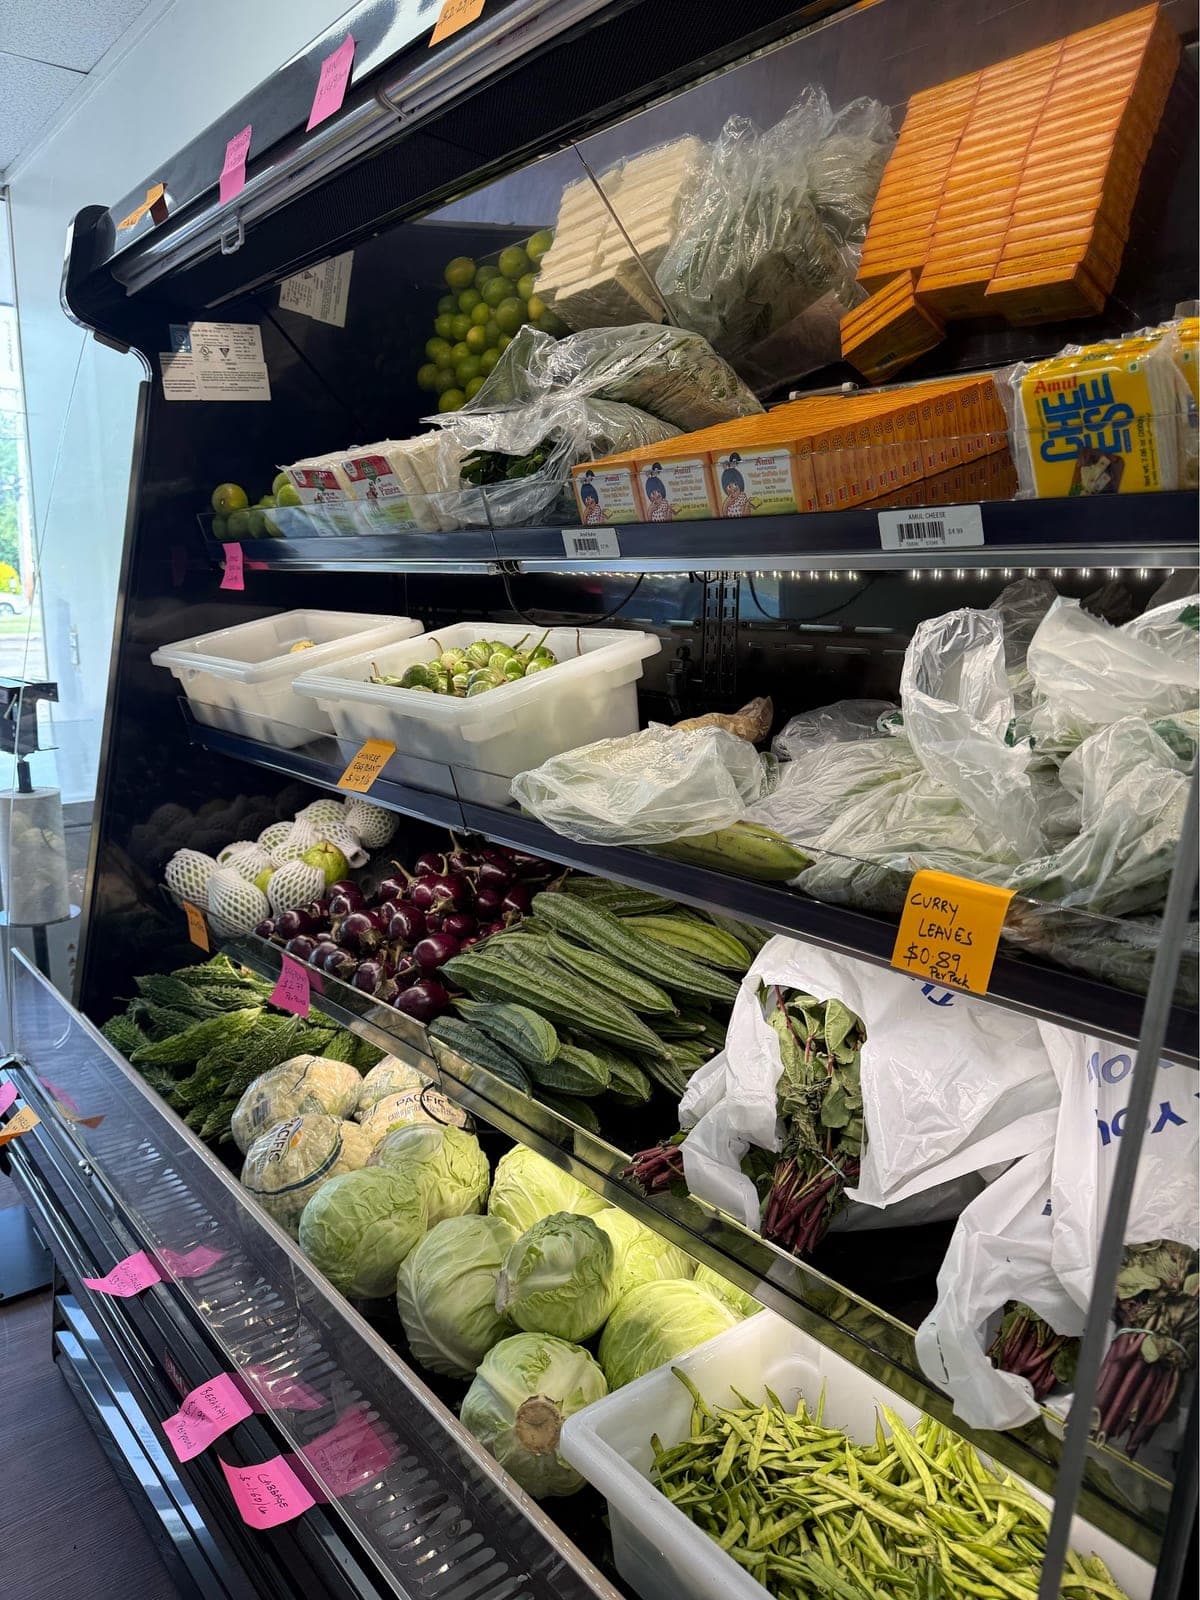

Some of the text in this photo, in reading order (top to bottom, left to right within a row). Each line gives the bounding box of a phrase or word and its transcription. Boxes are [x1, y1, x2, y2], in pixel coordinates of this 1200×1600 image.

[1033, 374, 1078, 394] Amul
[910, 893, 959, 926] CURRY
[918, 918, 973, 946] LEAVES
[903, 941, 962, 972] $0.89
[929, 965, 970, 989] Per Pack
[257, 1473, 289, 1508] CABBAGE
